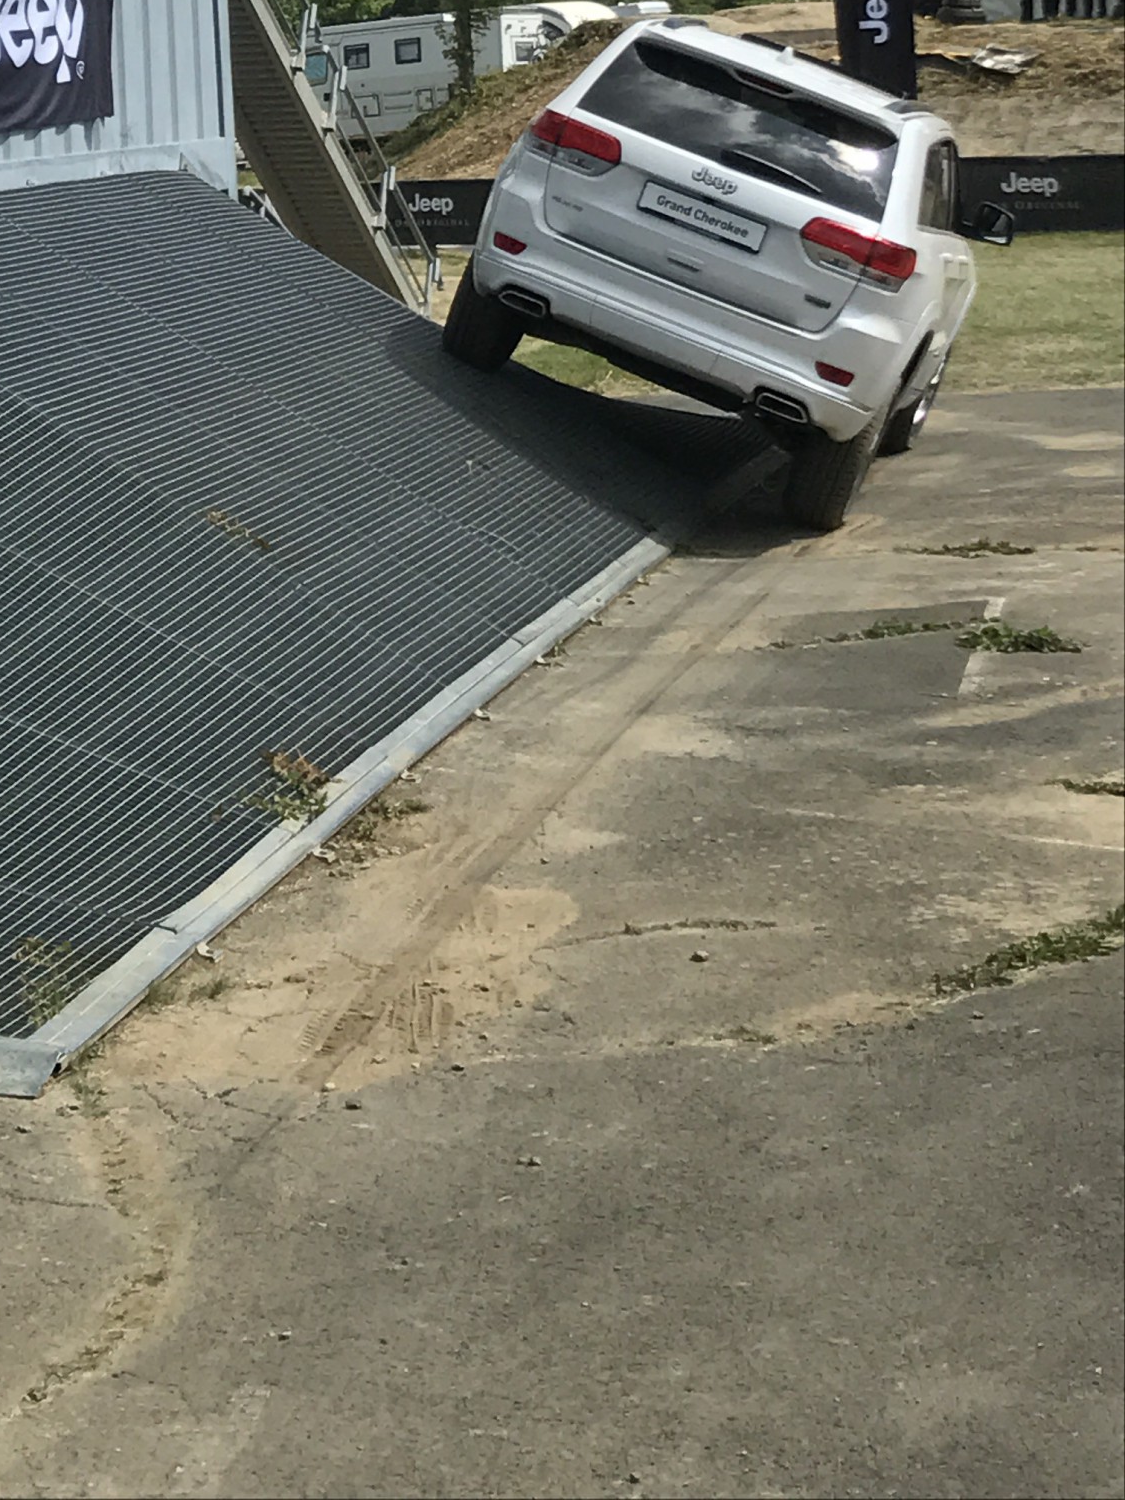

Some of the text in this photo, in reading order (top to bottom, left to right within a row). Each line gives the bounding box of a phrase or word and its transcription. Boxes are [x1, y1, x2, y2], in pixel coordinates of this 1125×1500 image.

[691, 166, 739, 195] Jeep
[1000, 171, 1059, 197] Jeep
[408, 193, 454, 215] Jeep
[656, 194, 749, 238] Grand Cherokee
